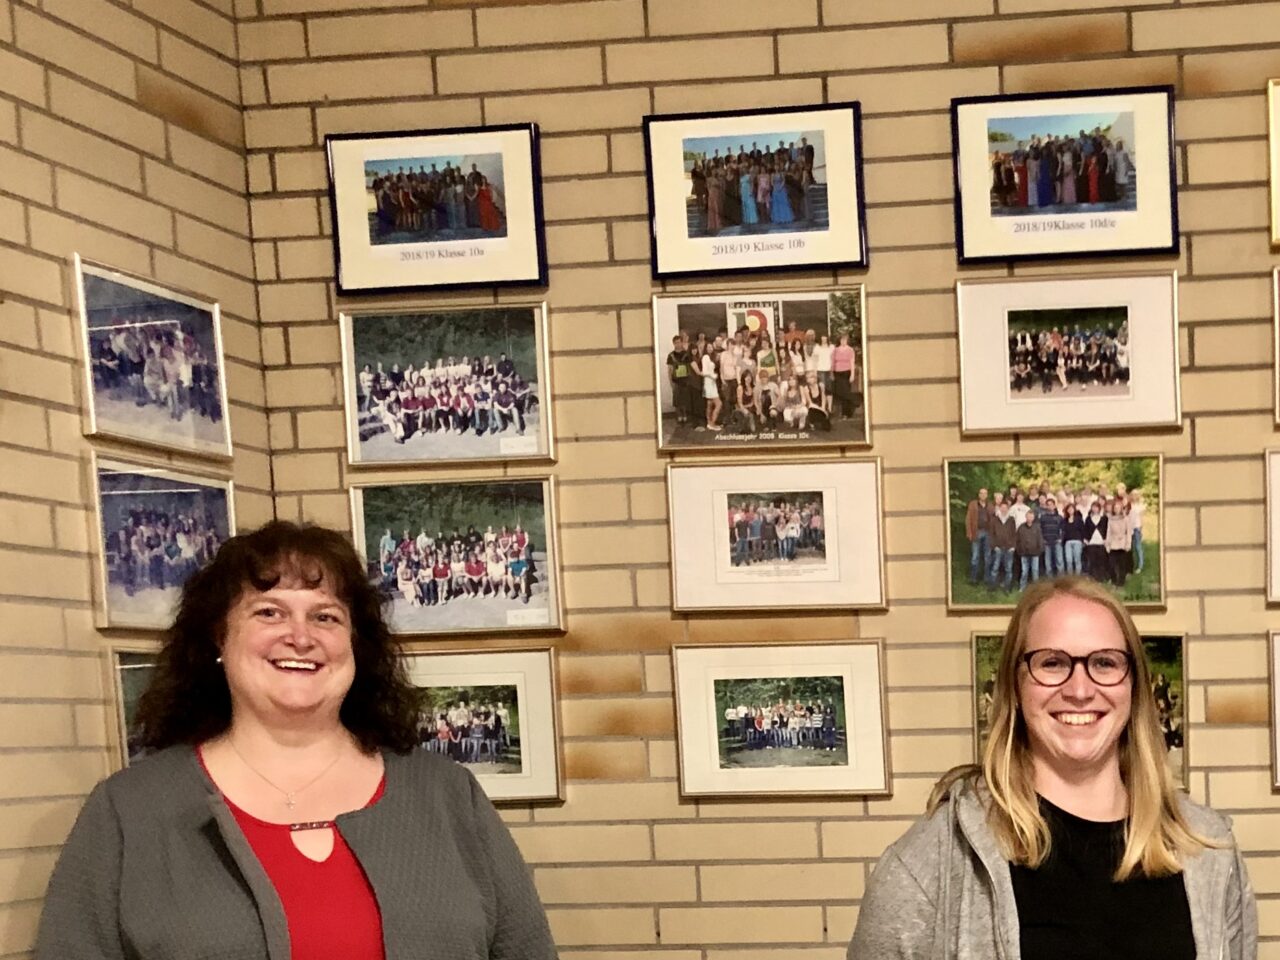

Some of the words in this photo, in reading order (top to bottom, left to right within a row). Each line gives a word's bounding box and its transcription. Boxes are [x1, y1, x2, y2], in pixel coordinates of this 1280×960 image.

[400, 249, 436, 261] 2018/19
[437, 248, 467, 258] Klasse
[468, 246, 486, 257] 10a
[711, 243, 751, 256] 2018/19
[753, 241, 785, 252] Klasse
[788, 239, 806, 249] 10b
